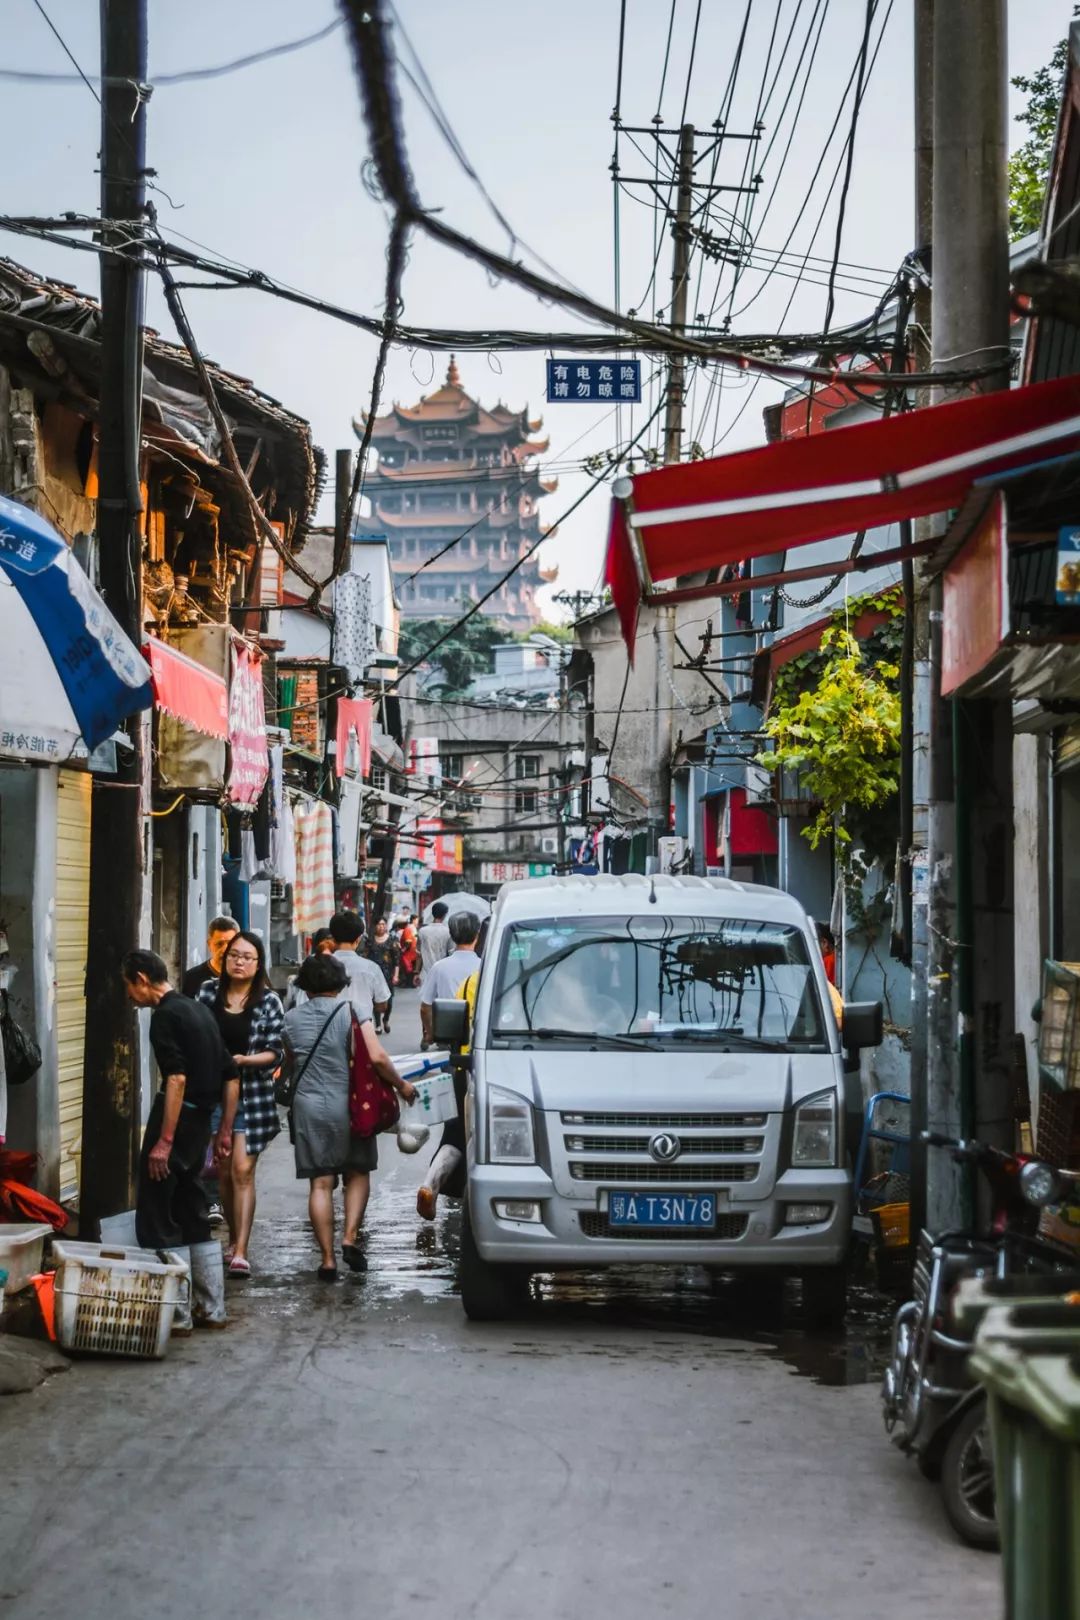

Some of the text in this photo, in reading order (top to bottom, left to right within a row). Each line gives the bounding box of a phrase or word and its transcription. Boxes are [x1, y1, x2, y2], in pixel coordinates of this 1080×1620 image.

[554, 365, 635, 381] 有电危险
[554, 382, 635, 397] 请勿晾晒
